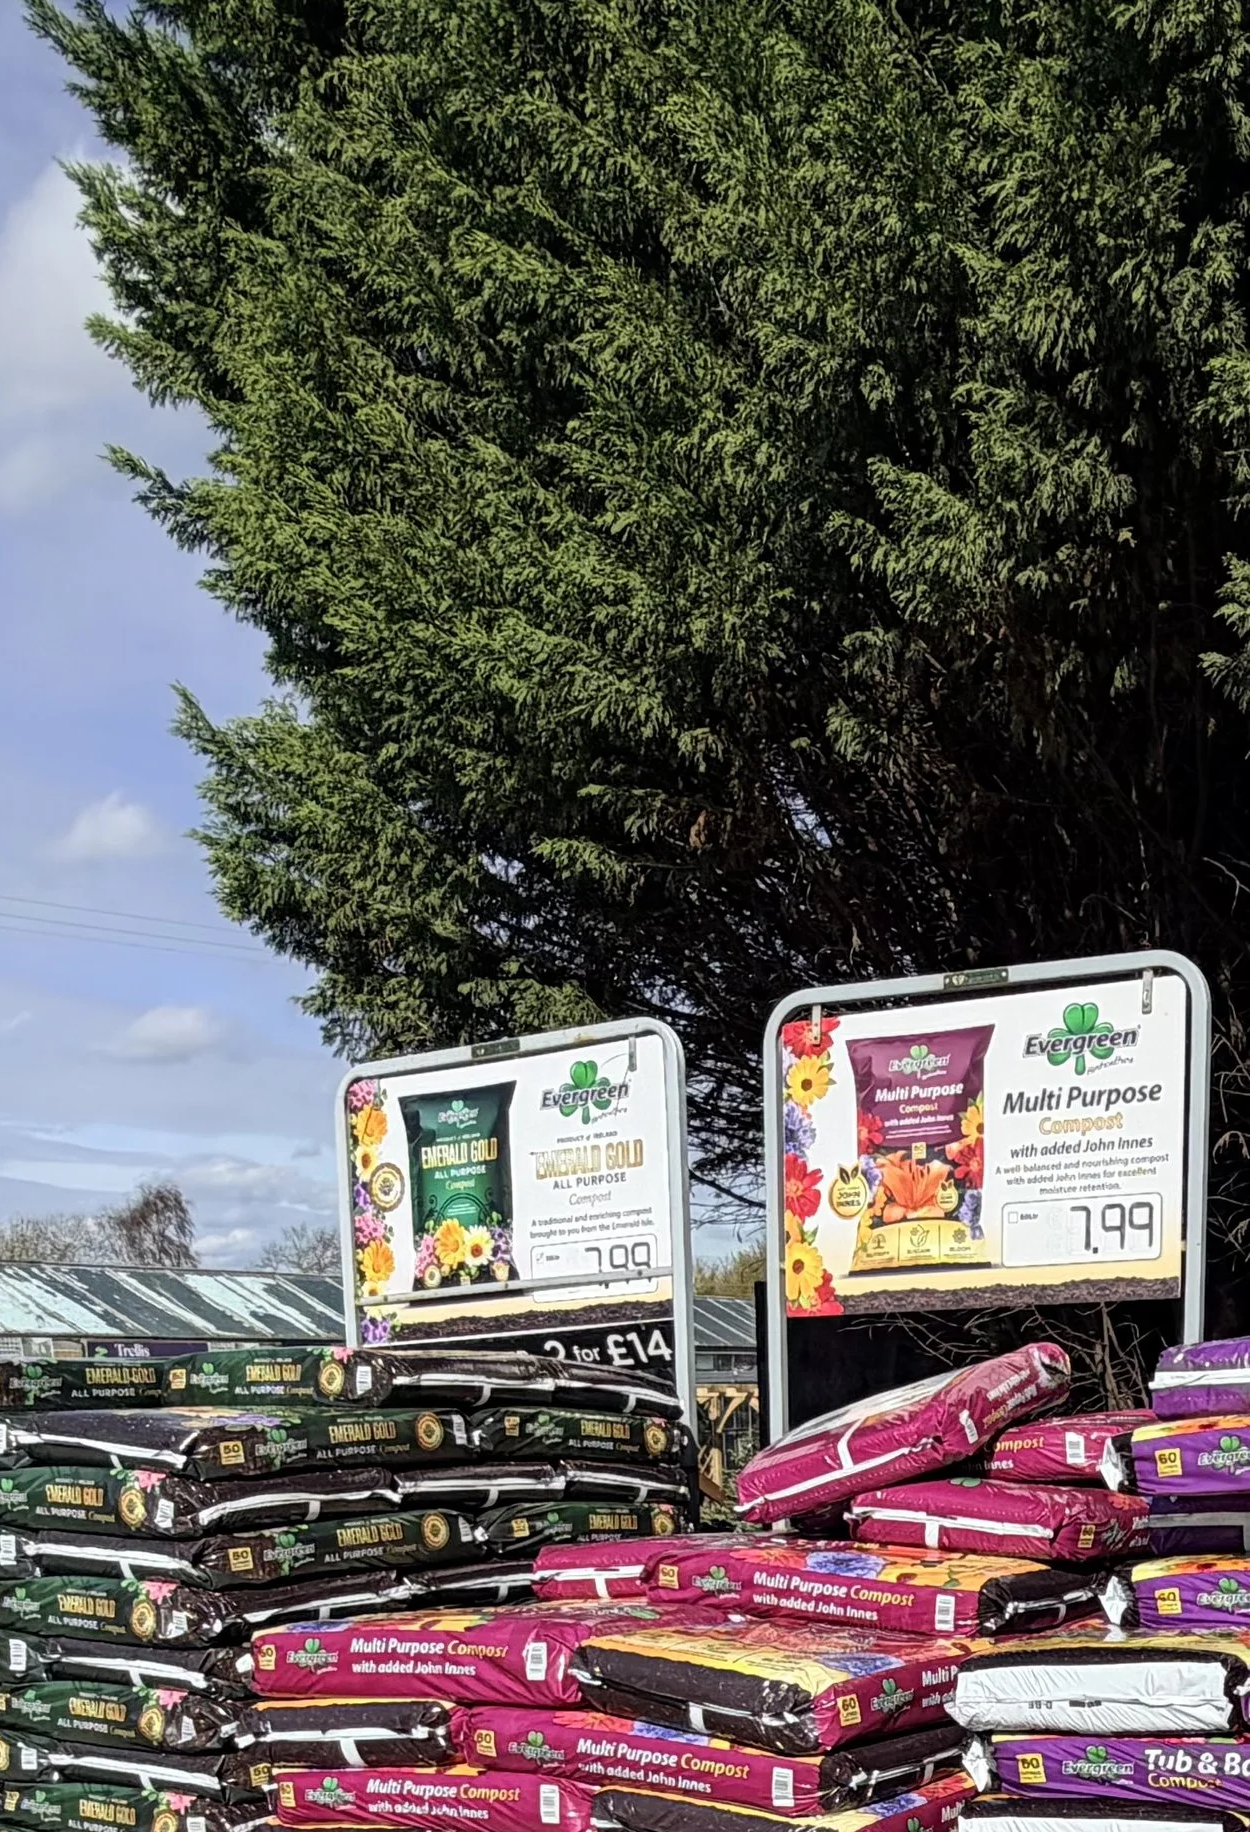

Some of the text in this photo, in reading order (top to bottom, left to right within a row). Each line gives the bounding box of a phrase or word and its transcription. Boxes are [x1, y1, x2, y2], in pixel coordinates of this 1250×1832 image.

[1024, 1030, 1137, 1054] Evergreen
[541, 1083, 629, 1106] Evergreen
[875, 1083, 964, 1102] Multi Purpose
[1003, 1083, 1162, 1115] Multi Purpose
[899, 1103, 938, 1113] Compost
[1039, 1112, 1123, 1136] Compost
[422, 1137, 498, 1169] EMERALD GOLD
[1010, 1137, 1153, 1158] with added John Innes
[536, 1139, 644, 1180] EMERALD GOLD
[995, 1153, 1169, 1174] A well balanced and nourishing compost
[435, 1165, 486, 1179] ALL PURPOSE
[553, 1172, 626, 1190] ALL PURPOSE
[1006, 1167, 1157, 1185] with added John Innes for excellent
[1039, 1184, 1077, 1195] moisture
[538, 1216, 573, 1226] traditional
[575, 1214, 588, 1223] and
[589, 1212, 621, 1221] enriching
[1070, 1202, 1153, 1254] 7.99
[530, 1230, 557, 1239] brought
[567, 1227, 580, 1236] you
[114, 1343, 150, 1357] Trellis
[572, 1345, 601, 1362] for
[607, 1329, 673, 1366] £14
[85, 1368, 156, 1383] EMERALD GOLD
[246, 1364, 302, 1382] EMERALD GOLD
[251, 1386, 285, 1394] PURPOSE
[329, 1422, 397, 1443] EMERALD GOLD
[224, 1445, 240, 1454] 50
[1158, 1453, 1177, 1465] 60
[46, 1484, 103, 1506] EMERALD GOLD
[36, 1506, 87, 1518] ALL PURPOSE
[337, 1523, 403, 1547] EMERALD GOLD
[232, 1551, 249, 1560] 50
[753, 1571, 915, 1607] Multi Purpose Compost
[752, 1593, 878, 1621] with added John Innes
[350, 1638, 509, 1658] Multi Purpose Compost
[576, 1738, 750, 1780] Multi Purpose Compost
[1063, 1761, 1134, 1775] Evergreen
[1145, 1749, 1219, 1774] Tub &
[606, 1766, 645, 1781] added
[646, 1771, 676, 1787] John
[677, 1778, 711, 1793] Innes
